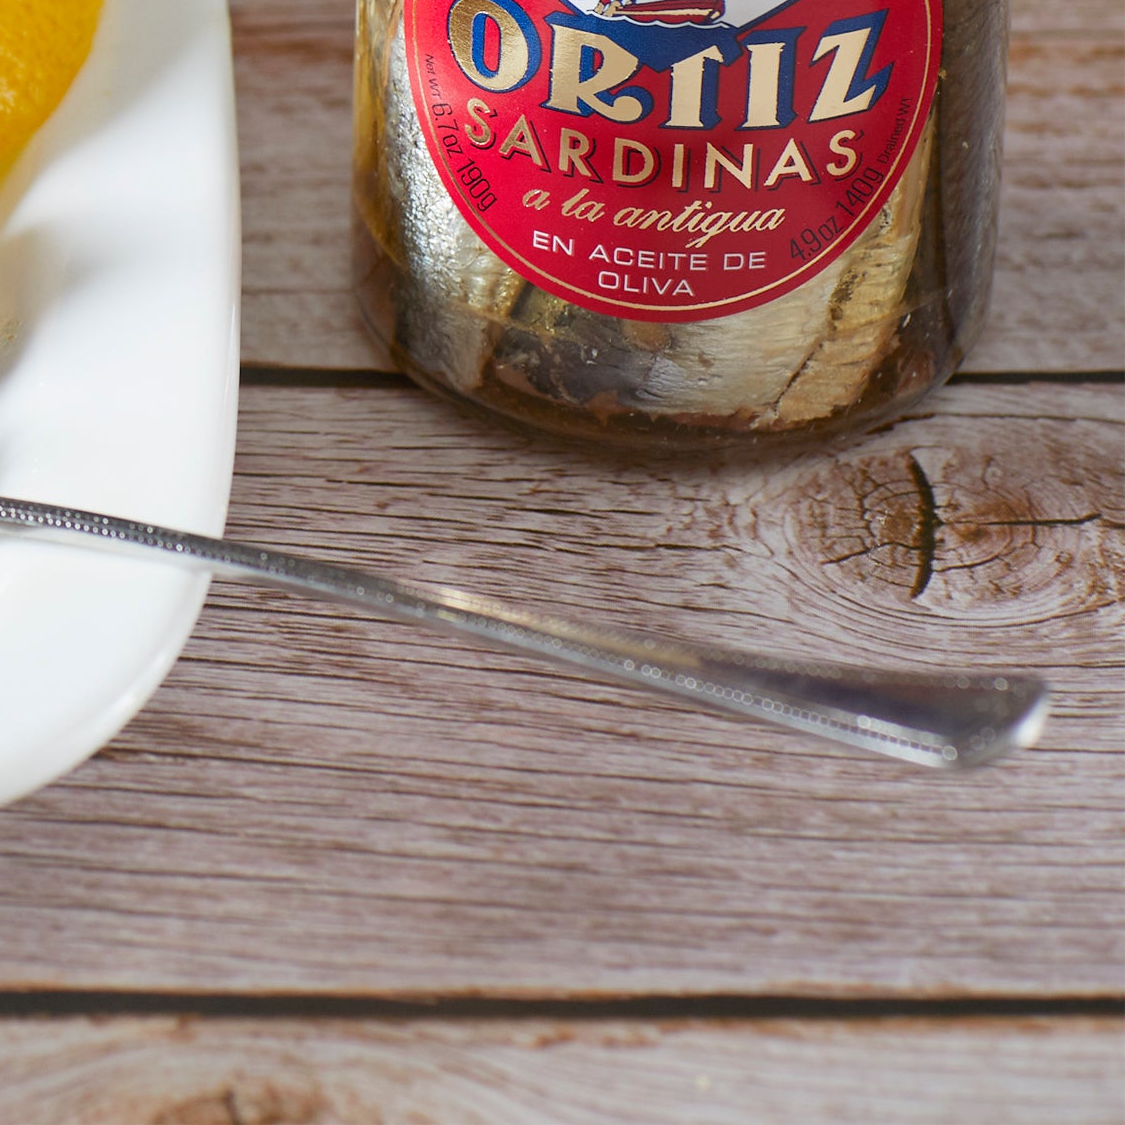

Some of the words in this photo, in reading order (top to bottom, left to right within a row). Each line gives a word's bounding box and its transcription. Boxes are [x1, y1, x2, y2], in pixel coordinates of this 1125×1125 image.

[464, 98, 862, 191] SARDINAS
[456, 158, 498, 212] 190g
[836, 167, 885, 217] 140g
[522, 188, 551, 211] a
[561, 188, 605, 223] la
[613, 200, 786, 249] antigua
[532, 229, 574, 256] EN
[588, 243, 708, 272] ACEITE
[723, 251, 766, 270] DE
[597, 270, 695, 298] OLIVA
